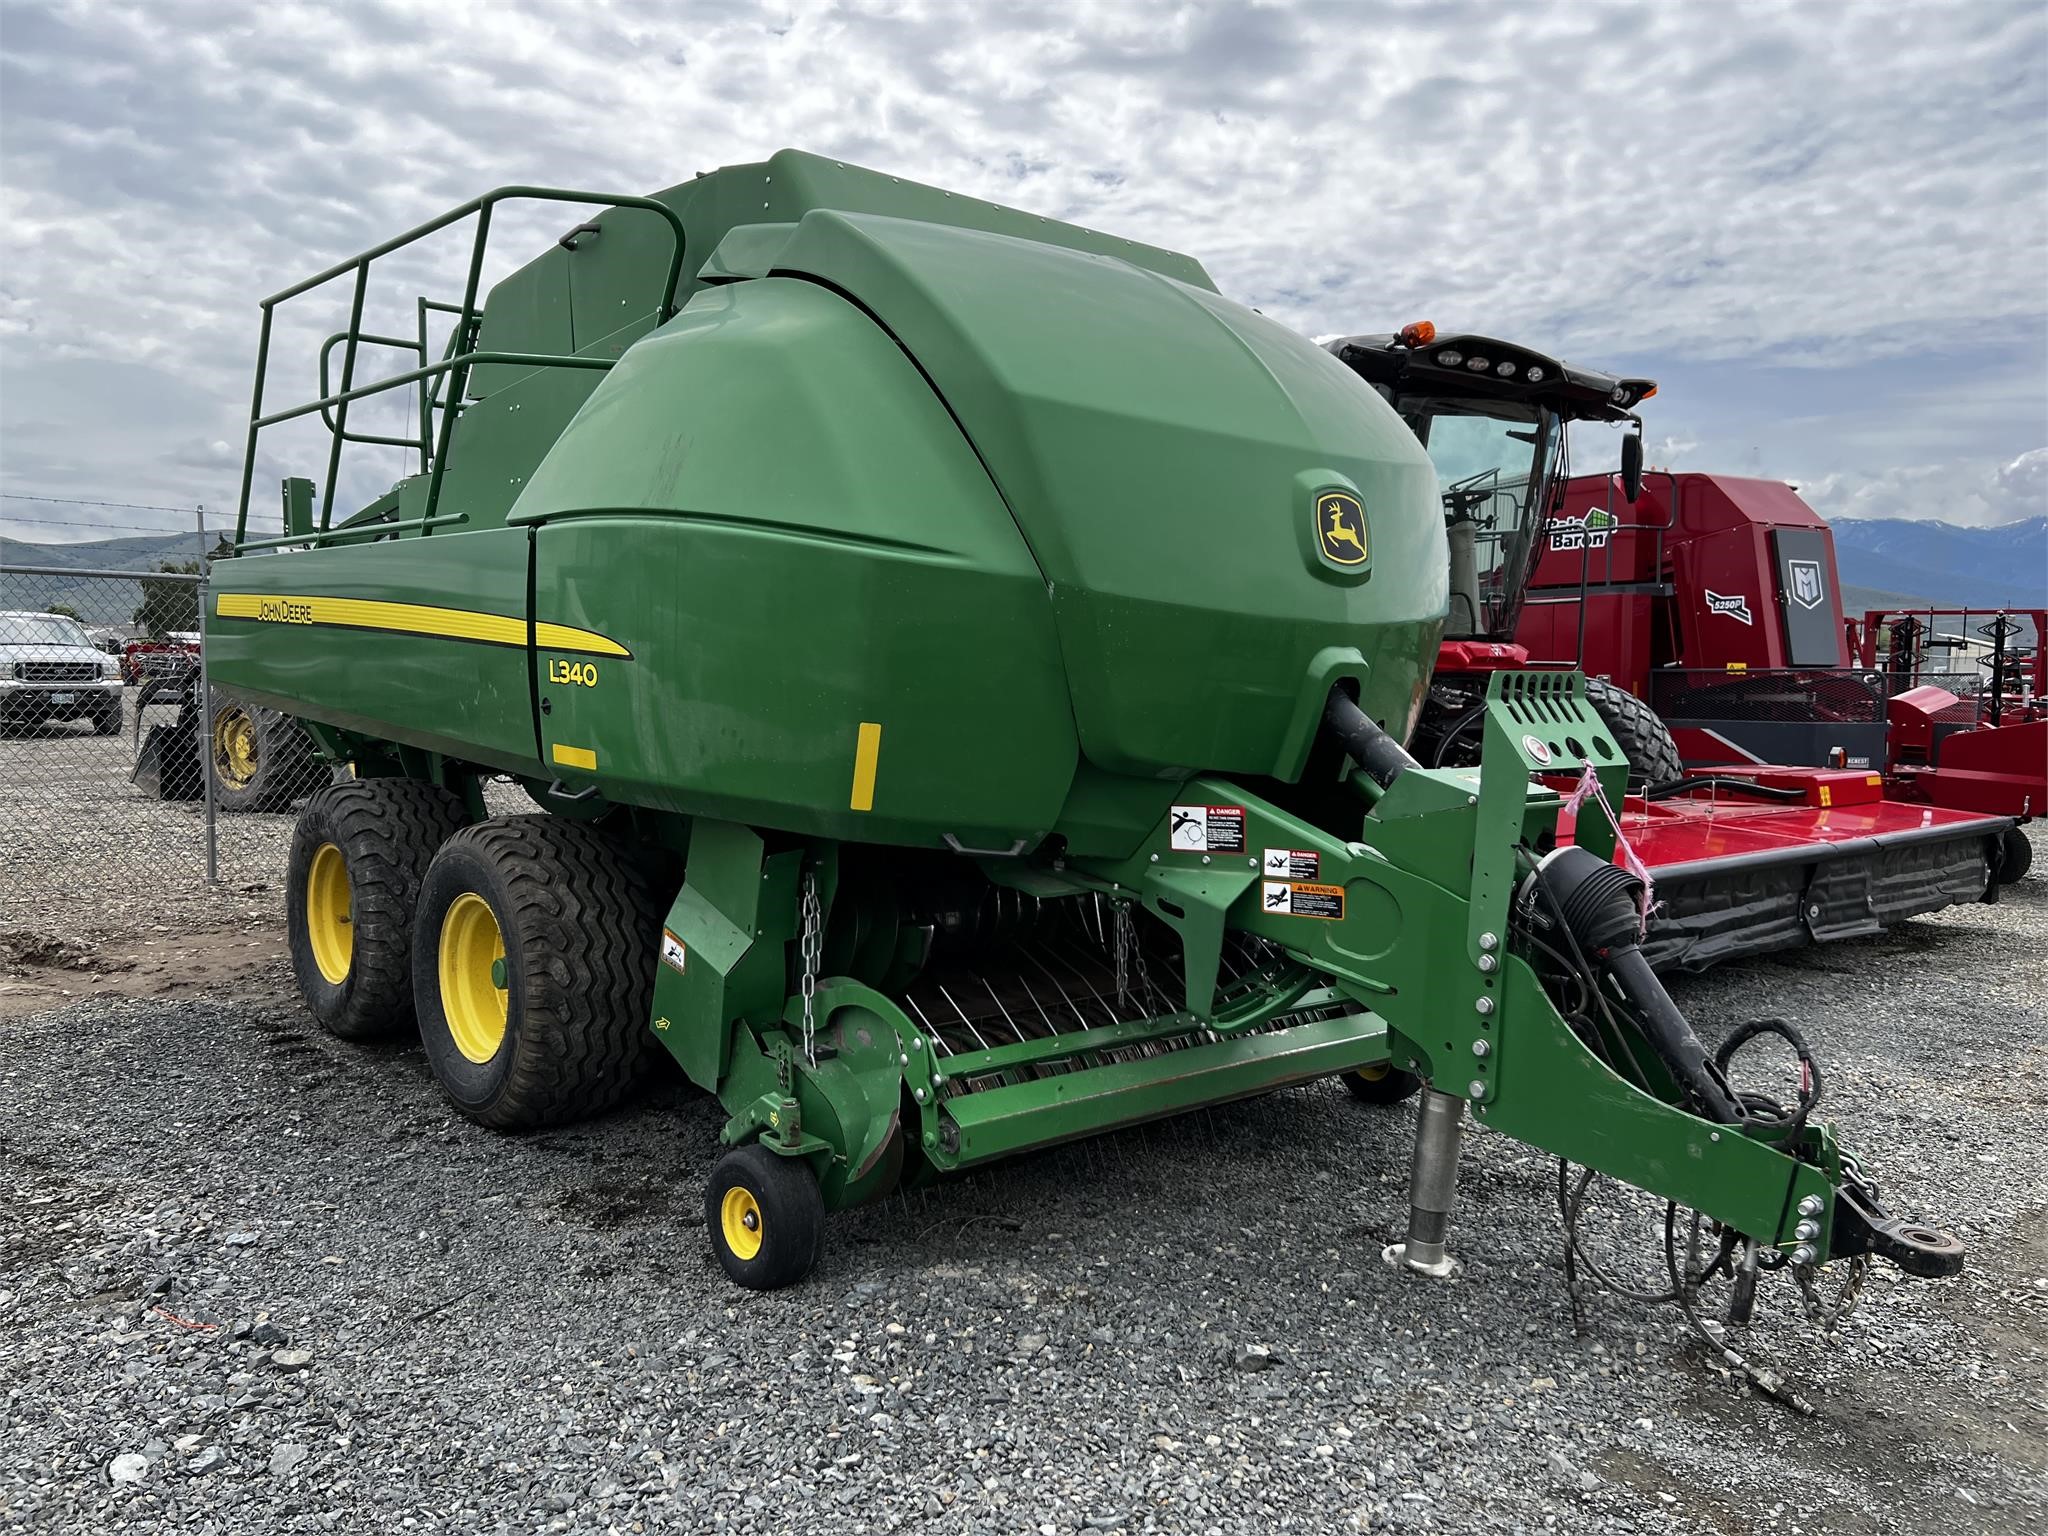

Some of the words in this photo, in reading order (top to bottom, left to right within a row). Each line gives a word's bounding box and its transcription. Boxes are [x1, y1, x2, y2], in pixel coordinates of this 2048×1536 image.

[1552, 533, 1603, 548] Baron
[258, 600, 281, 619] JOHN
[281, 600, 312, 622] DEERE
[1715, 600, 1742, 609] 5250P
[549, 659, 598, 687] L340
[1304, 885, 1338, 894] WARNING
